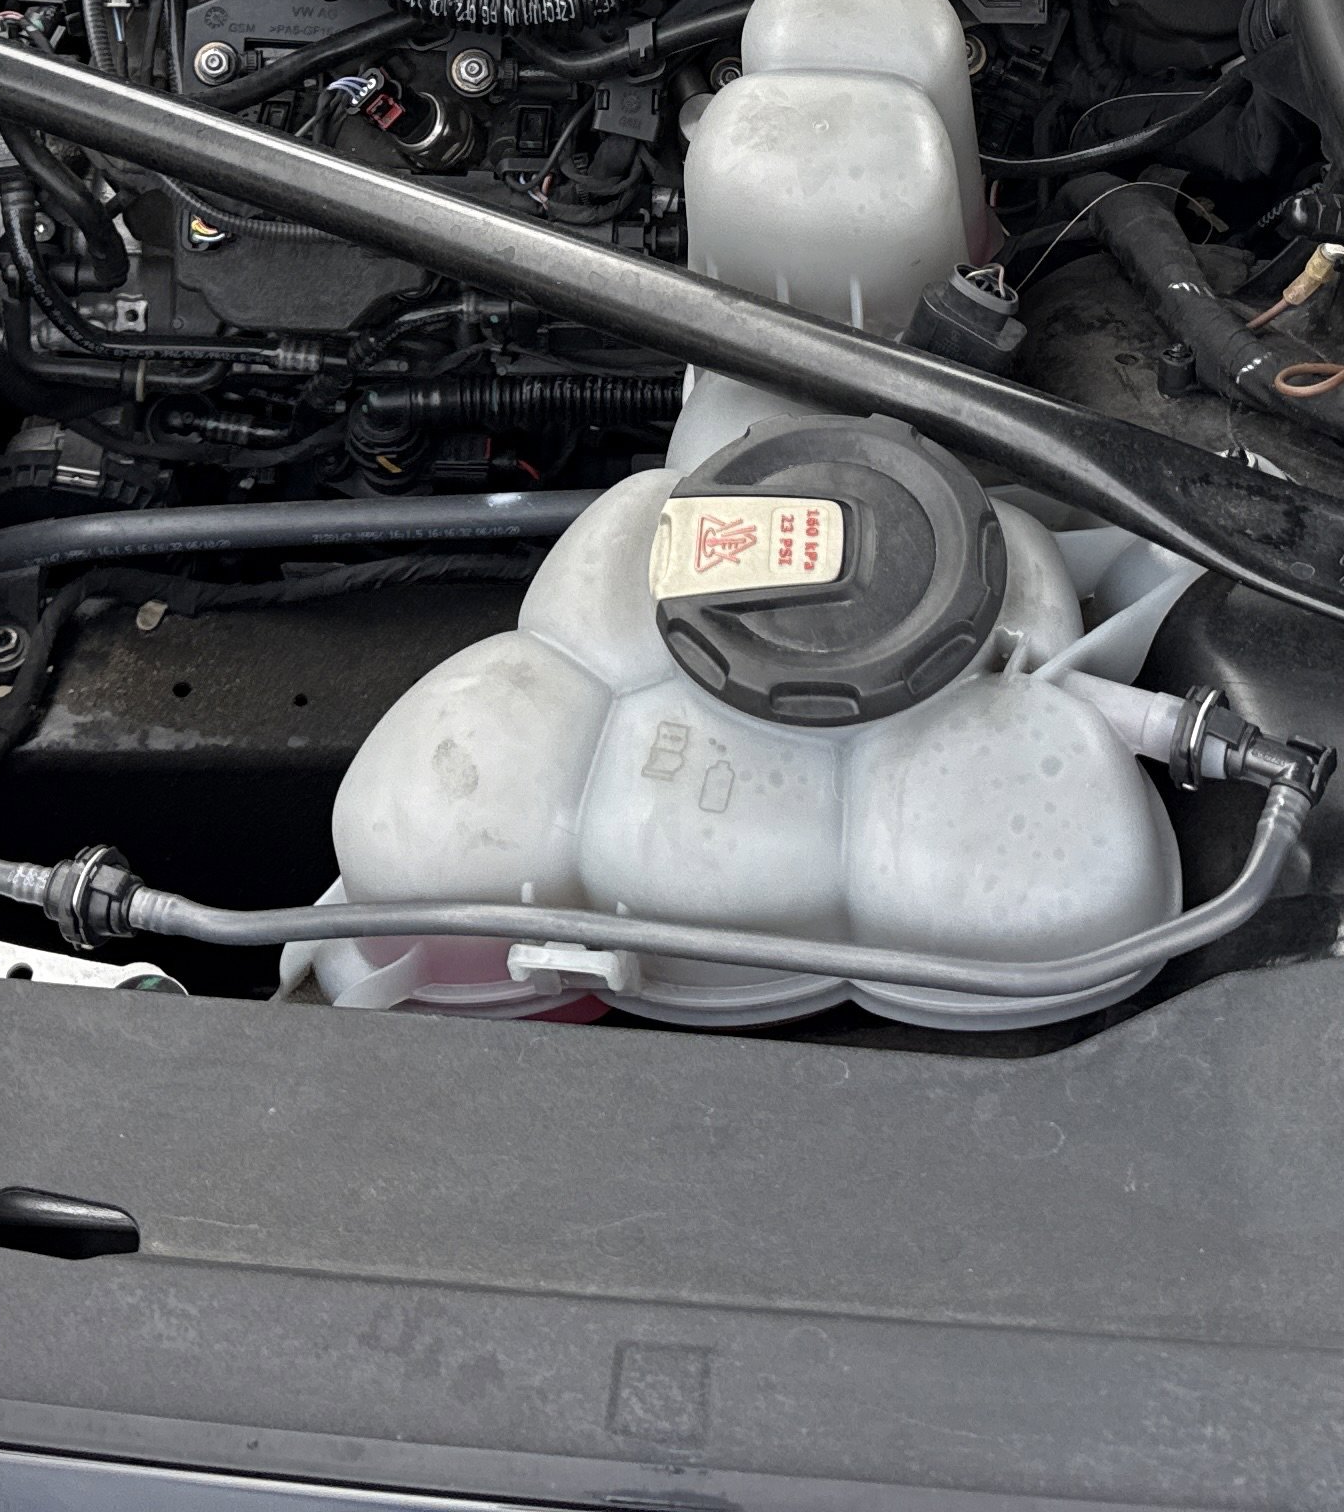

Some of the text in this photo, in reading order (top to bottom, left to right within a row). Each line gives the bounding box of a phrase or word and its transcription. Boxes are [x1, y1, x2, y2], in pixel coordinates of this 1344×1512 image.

[291, 6, 315, 18] VW
[778, 513, 795, 567] 23 PSI
[803, 541, 819, 571] kPa
